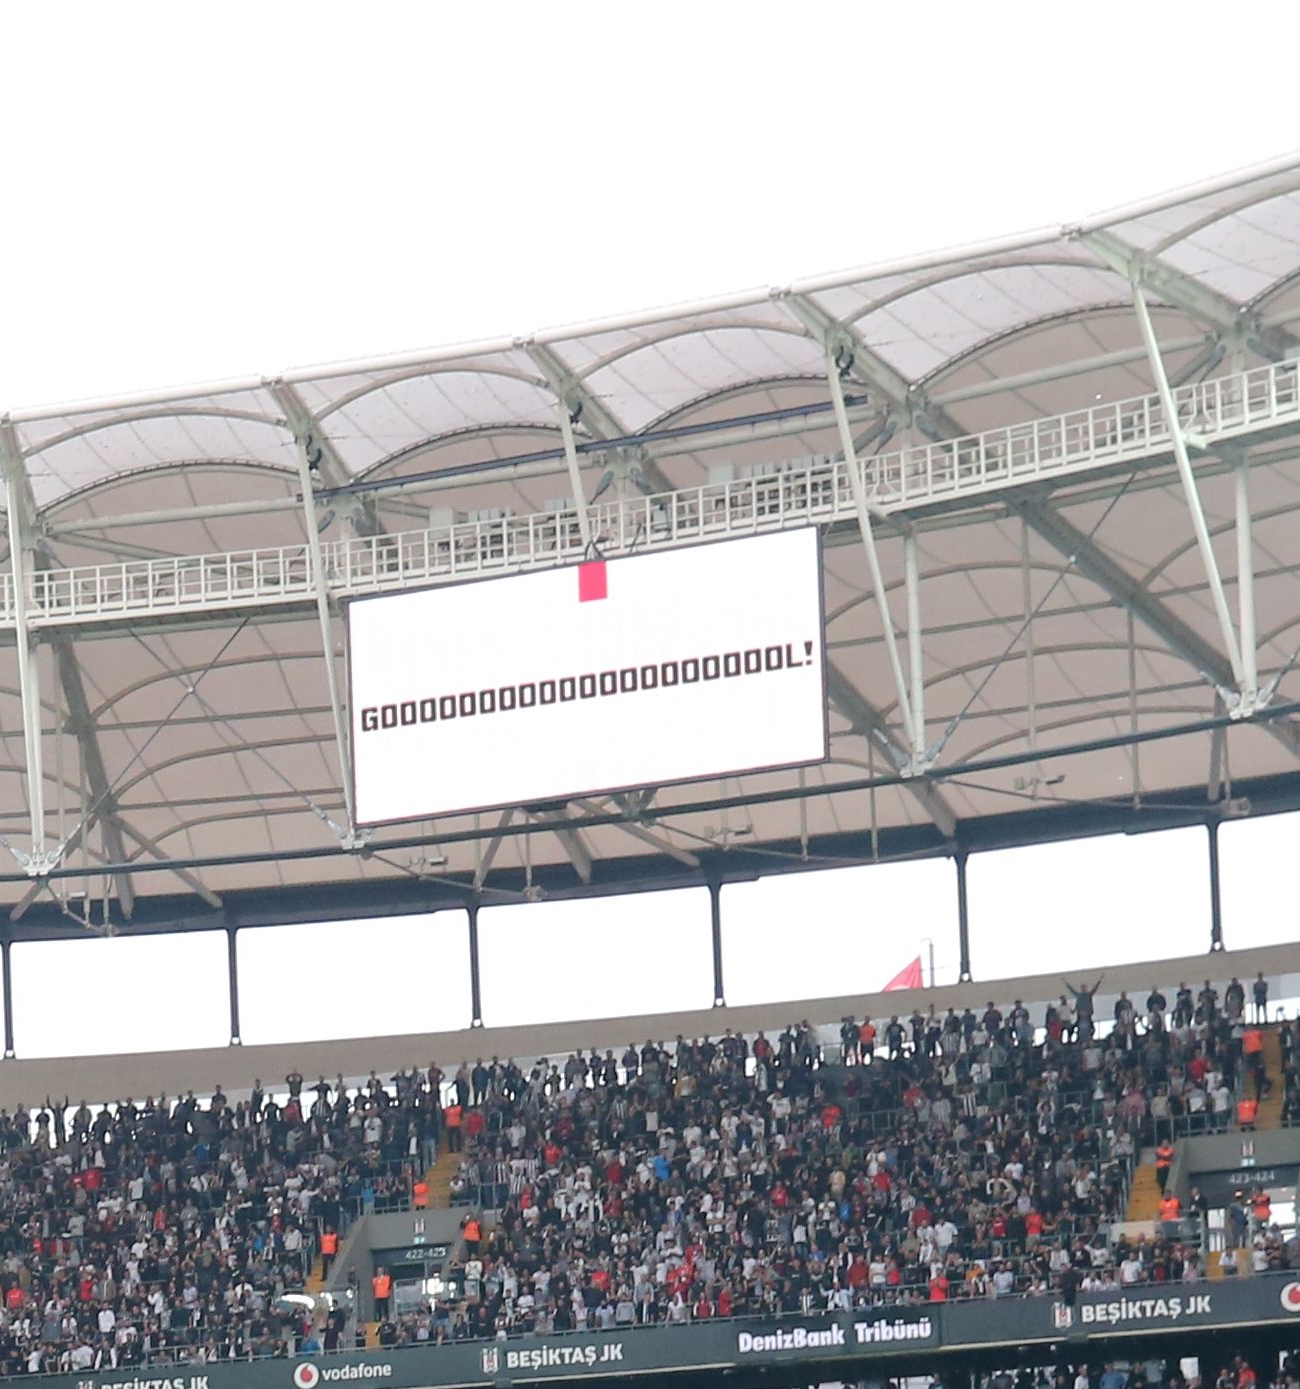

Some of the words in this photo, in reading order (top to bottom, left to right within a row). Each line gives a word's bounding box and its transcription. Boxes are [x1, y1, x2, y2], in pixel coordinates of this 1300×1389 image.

[1081, 1297, 1181, 1324] BEŞİKTAŞ
[1184, 1294, 1211, 1316] JK
[737, 1321, 845, 1354] DenizBank
[853, 1315, 933, 1344] Tribünü
[321, 1361, 392, 1383] vodafone
[506, 1344, 598, 1372] BEŞİKTAŞ
[599, 1342, 623, 1362] JK
